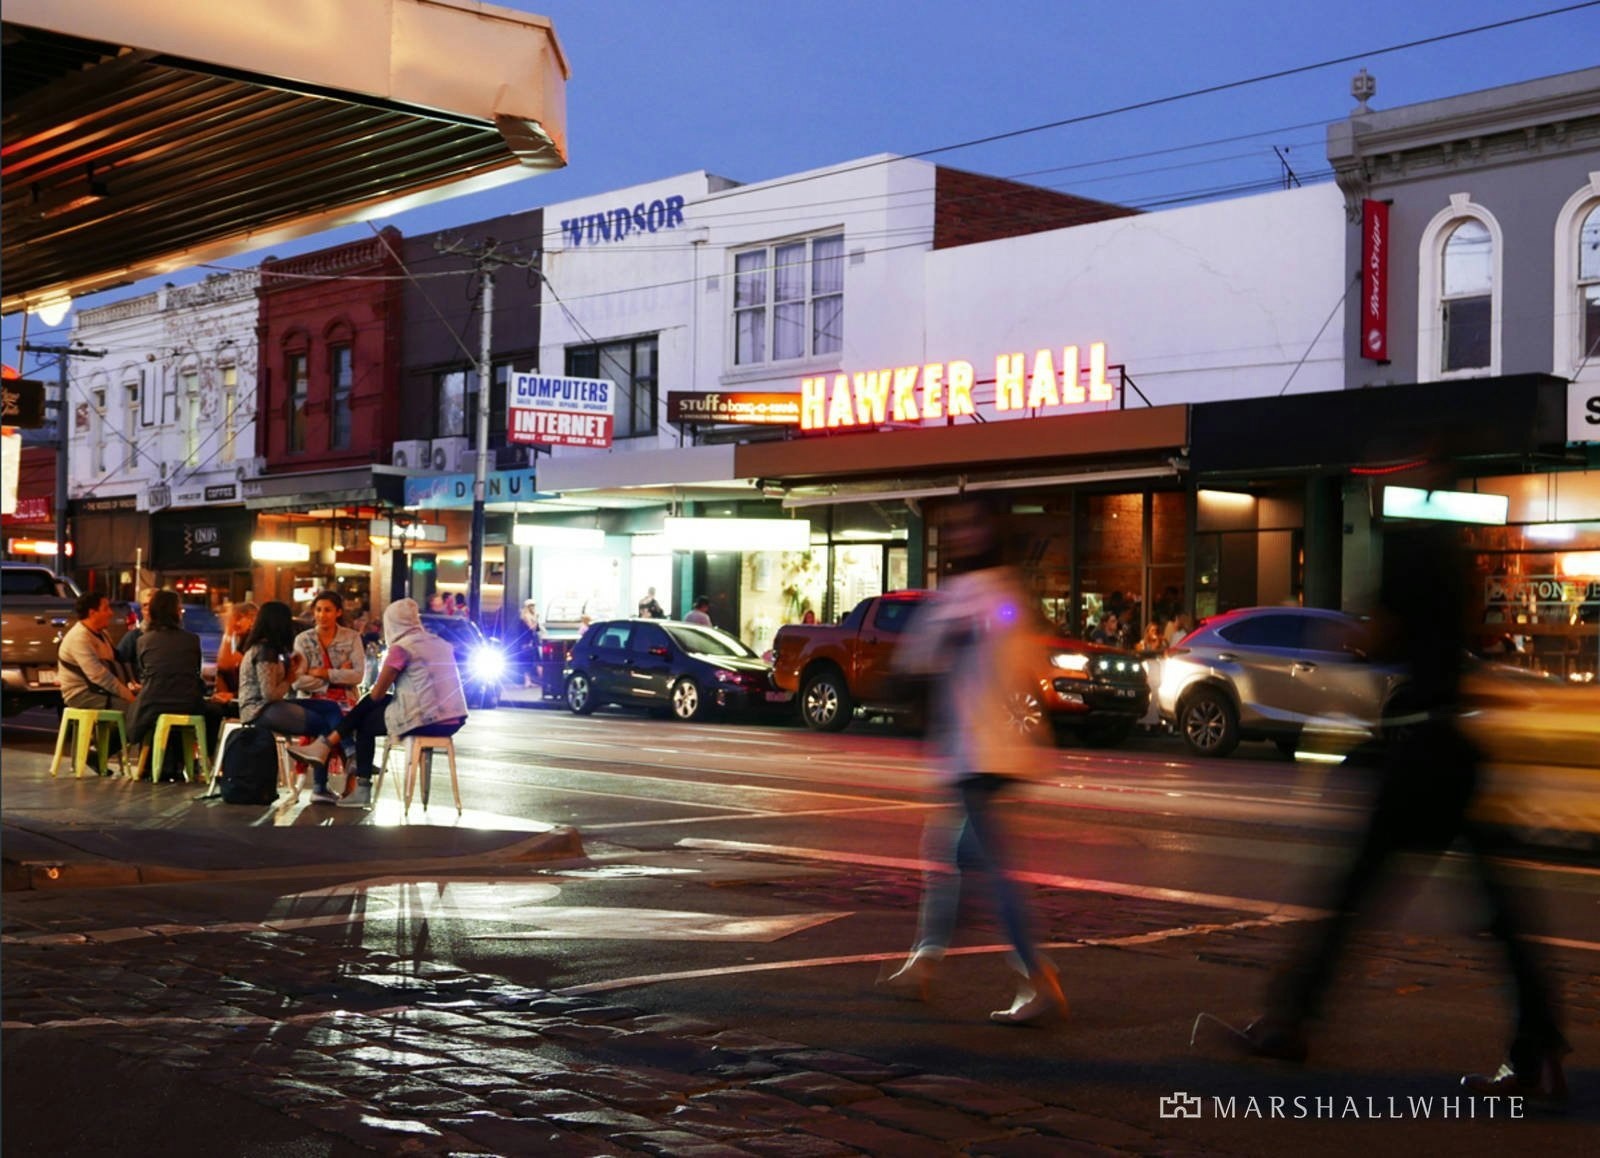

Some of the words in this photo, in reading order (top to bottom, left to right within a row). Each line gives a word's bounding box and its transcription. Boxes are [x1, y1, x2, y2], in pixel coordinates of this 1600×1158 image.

[560, 195, 685, 247] WINDSOR
[517, 376, 609, 403] COMPUTERS
[800, 359, 976, 430] HAWKER
[995, 342, 1113, 411] HALL
[514, 410, 608, 438] INTERNET
